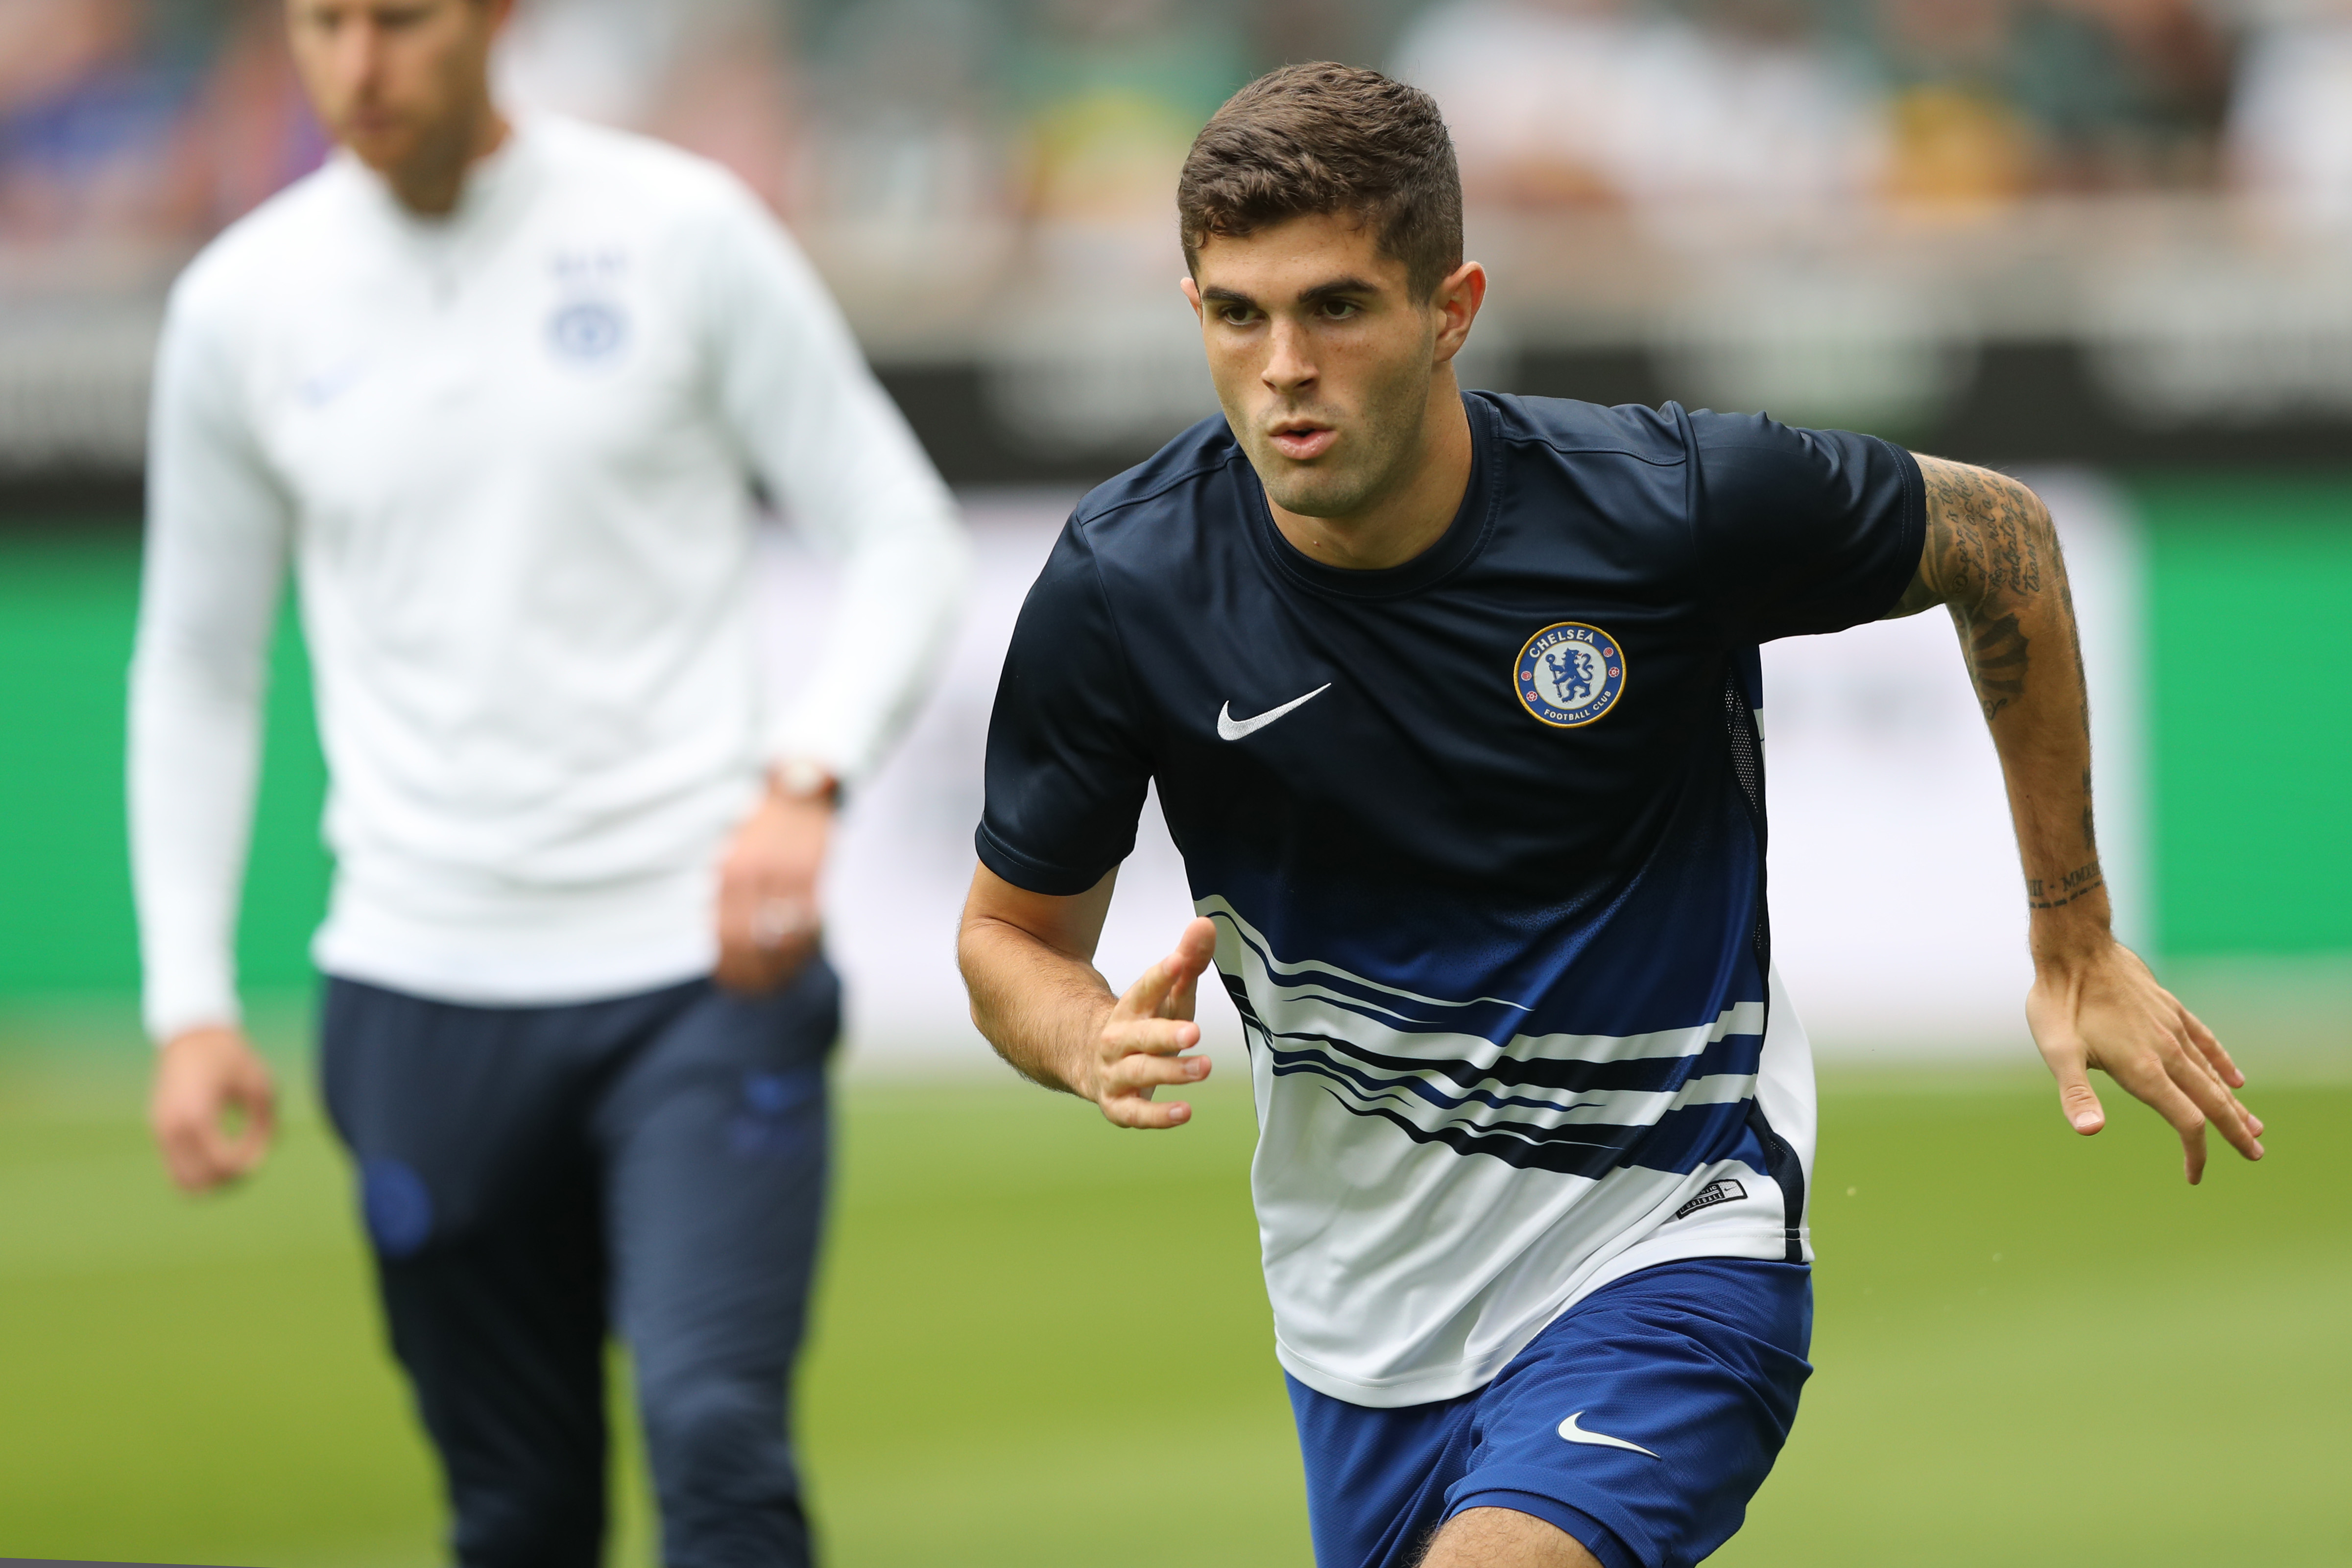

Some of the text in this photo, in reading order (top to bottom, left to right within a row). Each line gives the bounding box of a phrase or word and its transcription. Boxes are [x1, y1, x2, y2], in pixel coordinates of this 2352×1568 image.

[1529, 629, 1594, 658] CHELSEA
[1544, 690, 1611, 721] FOOTBALL CLUB
